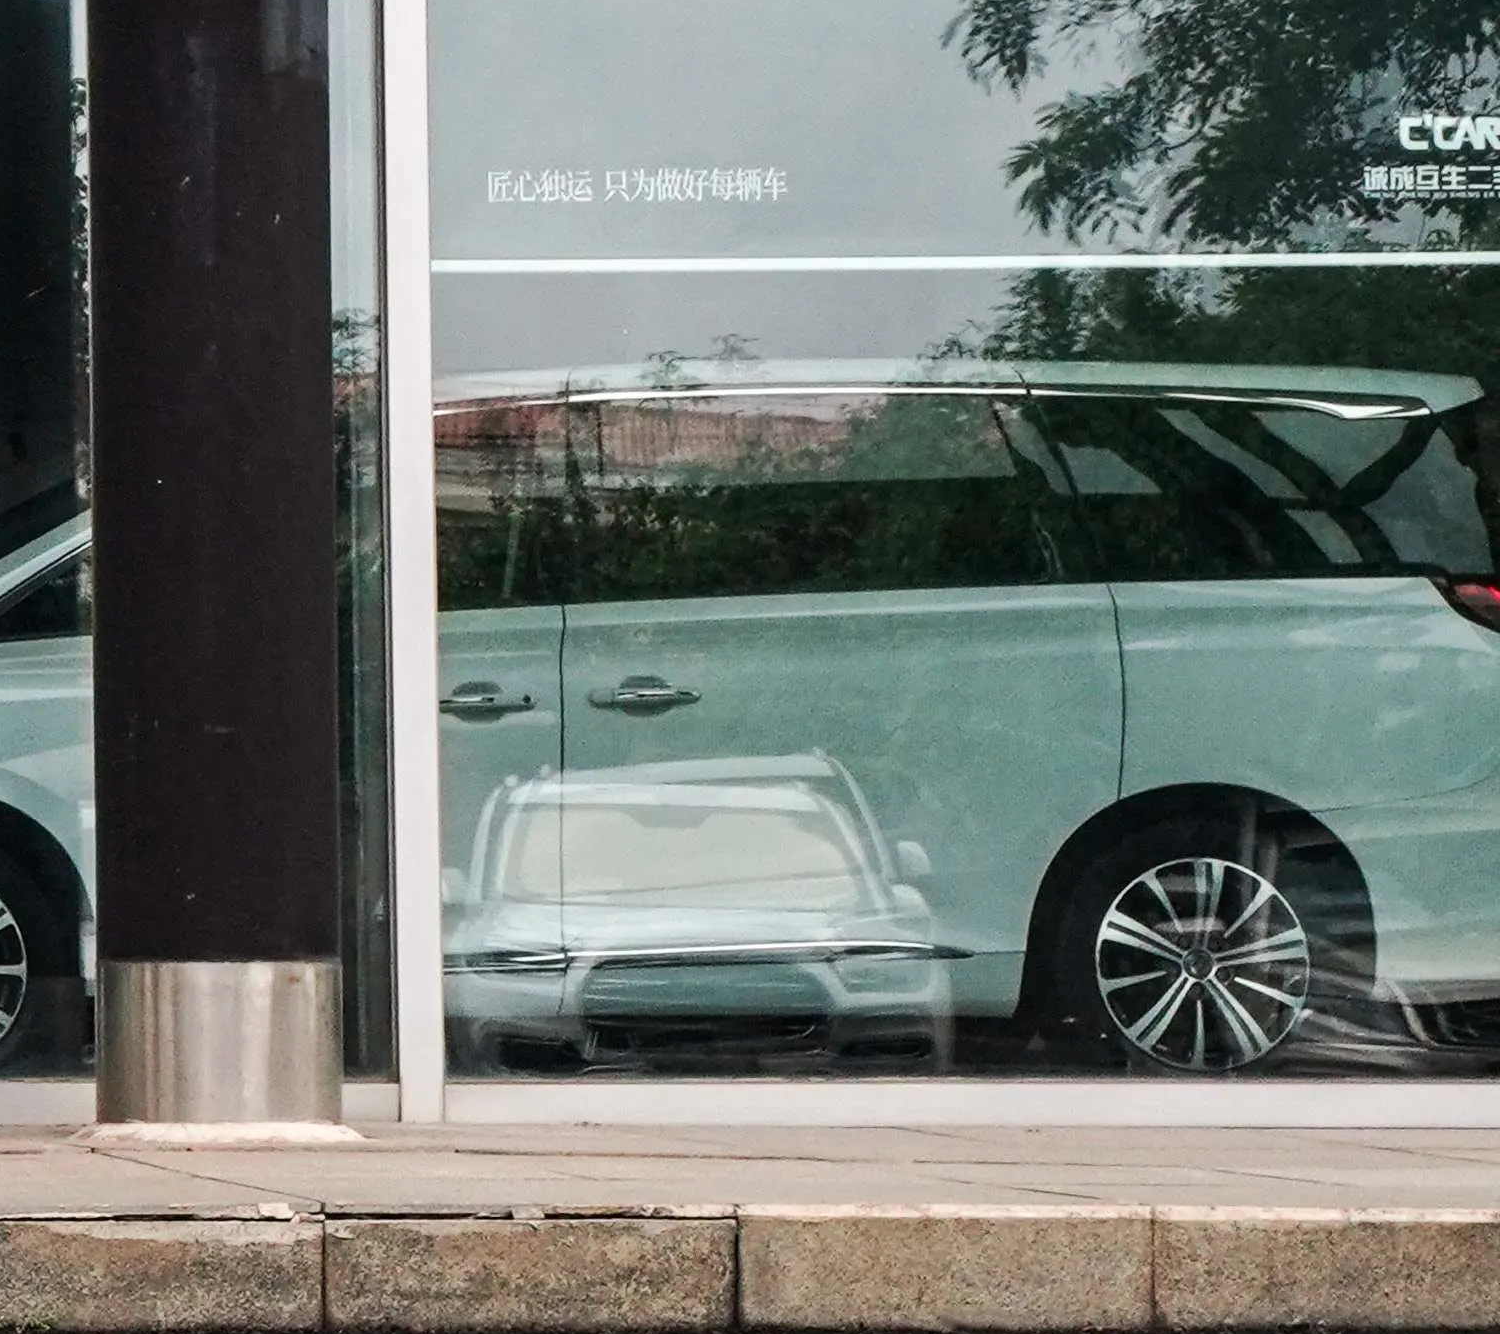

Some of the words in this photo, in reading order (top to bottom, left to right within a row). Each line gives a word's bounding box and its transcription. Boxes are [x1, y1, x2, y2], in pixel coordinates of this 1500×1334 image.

[487, 169, 594, 203] 匠心独运
[604, 167, 789, 202] 只为做好每辆车
